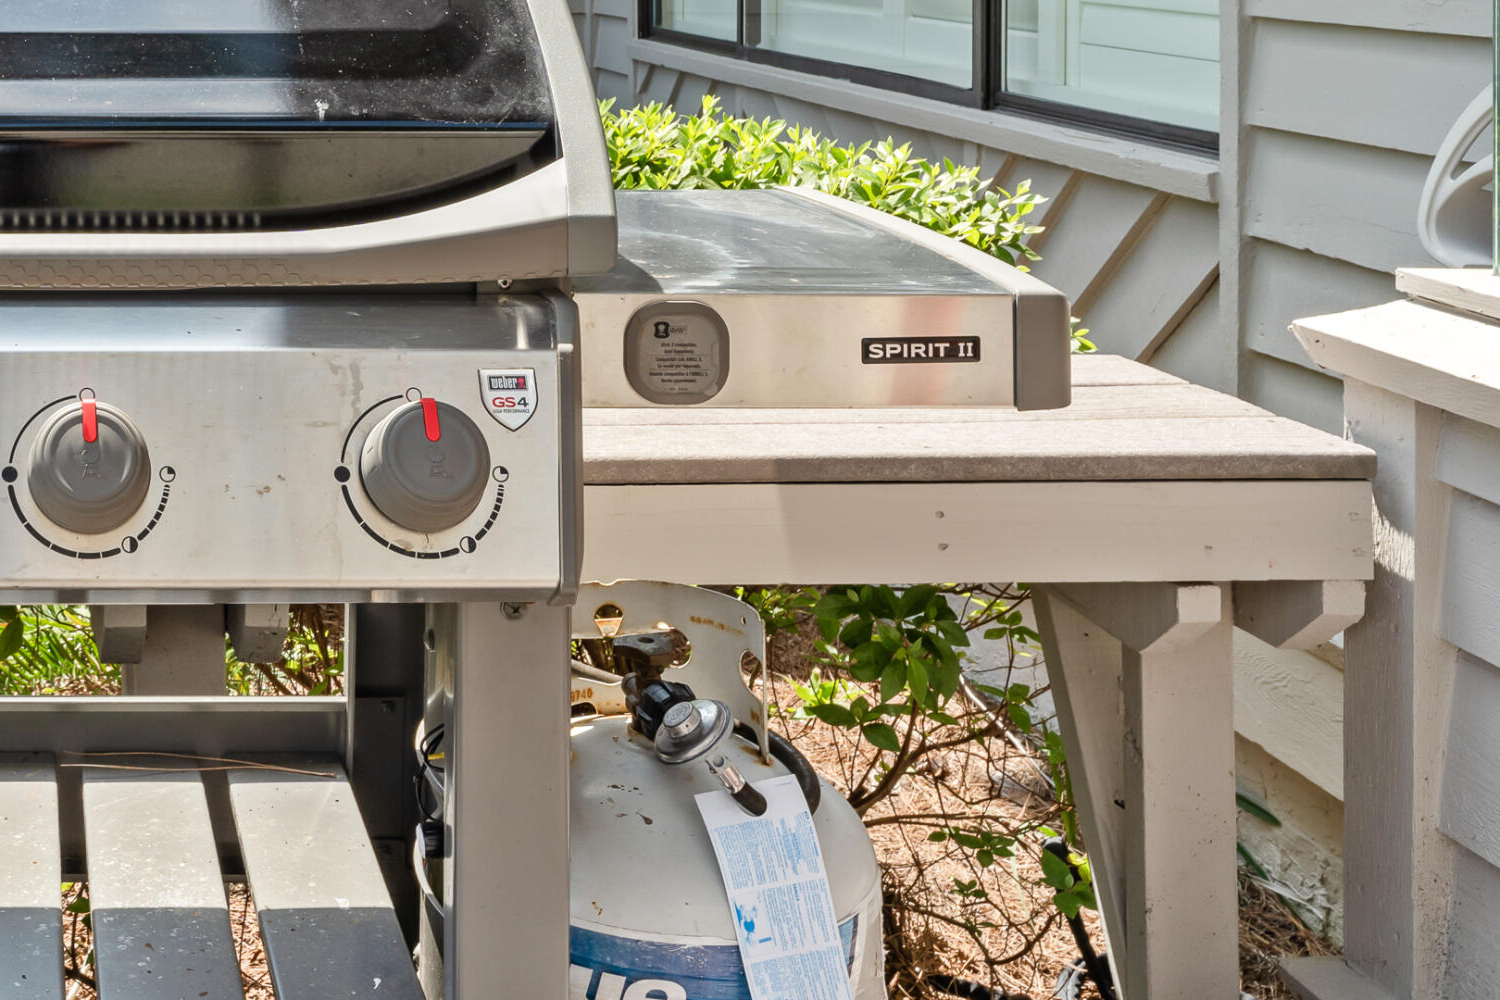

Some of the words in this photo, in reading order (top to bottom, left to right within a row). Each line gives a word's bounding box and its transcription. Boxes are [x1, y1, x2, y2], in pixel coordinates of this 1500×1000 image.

[868, 343, 950, 358] SPIRIT
[958, 342, 974, 357] II
[490, 376, 517, 389] weber
